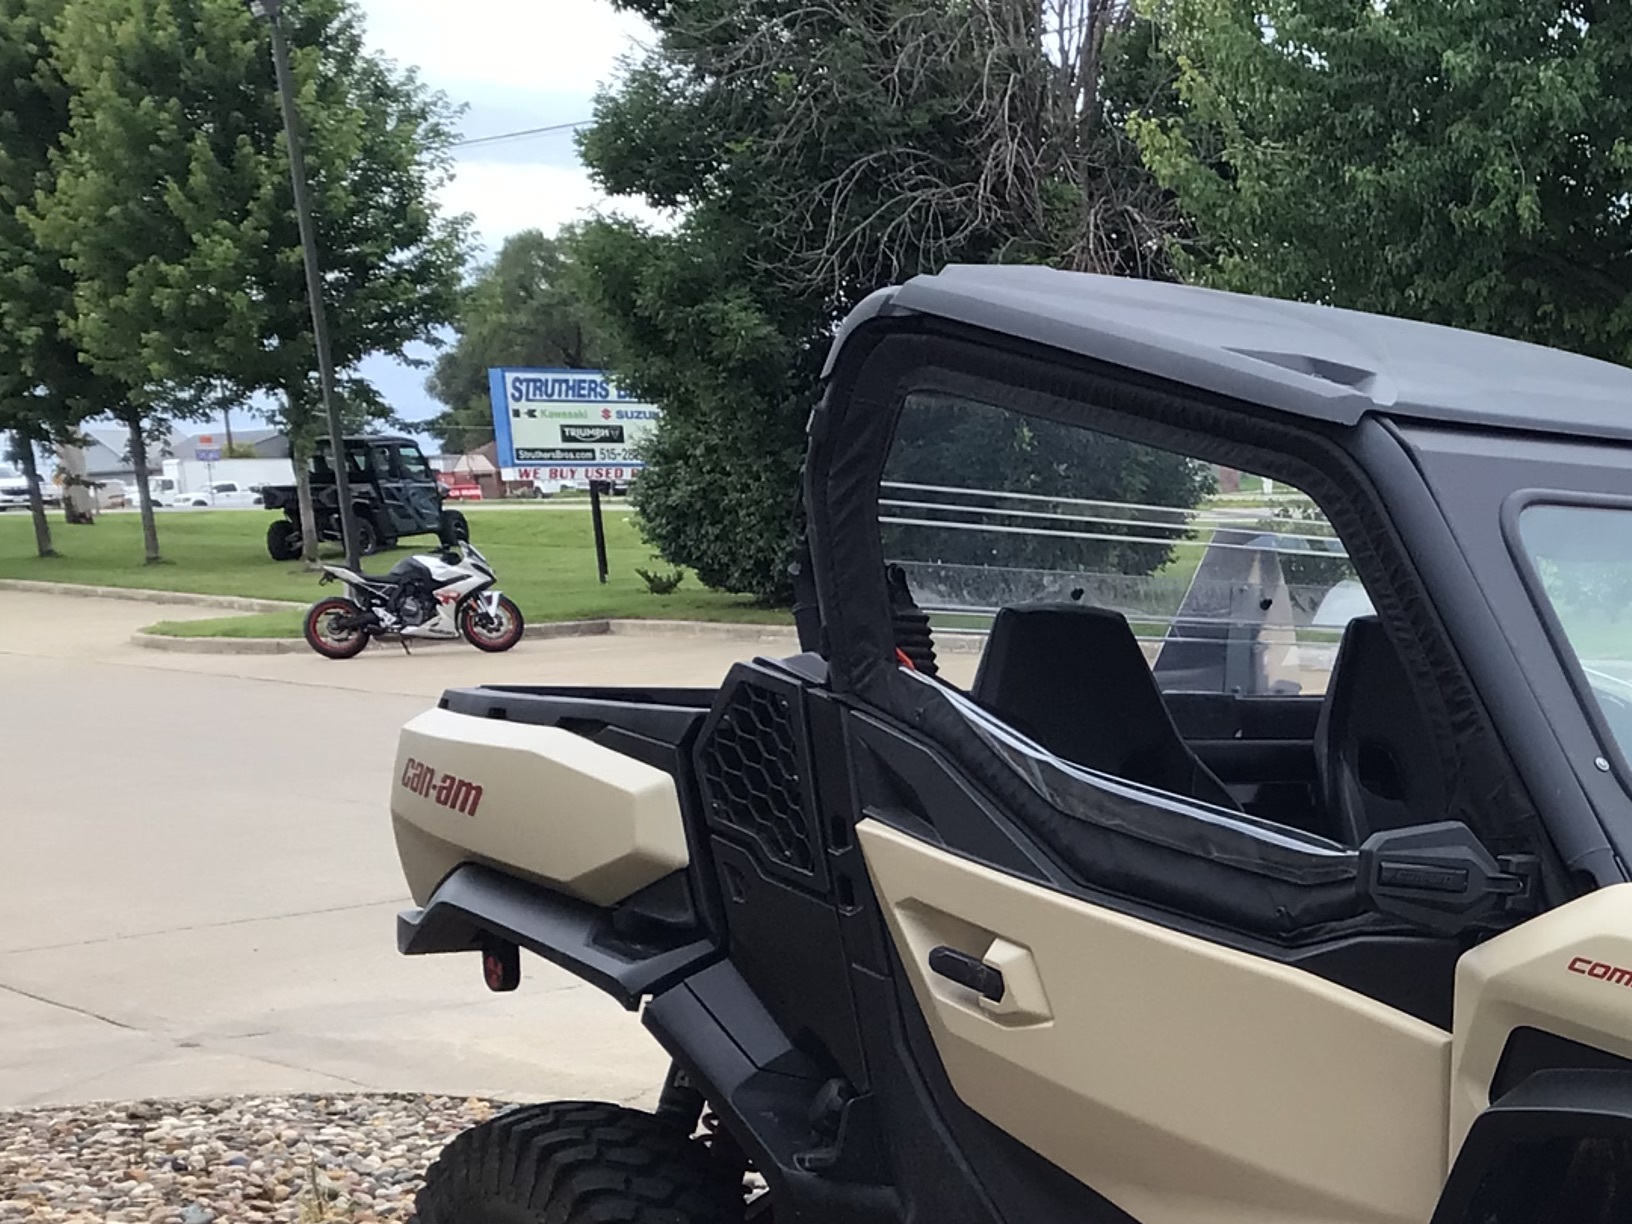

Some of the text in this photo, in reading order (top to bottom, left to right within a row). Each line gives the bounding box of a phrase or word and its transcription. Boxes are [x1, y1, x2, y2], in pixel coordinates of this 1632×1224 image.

[511, 376, 610, 402] STRUTHERS
[540, 409, 588, 419] Kawasaki
[616, 409, 660, 420] SUZUK
[564, 427, 610, 438] TRIUMPH
[518, 468, 541, 479] WE
[550, 468, 577, 479] BUY
[585, 468, 624, 480] USED
[402, 757, 484, 816] can-am
